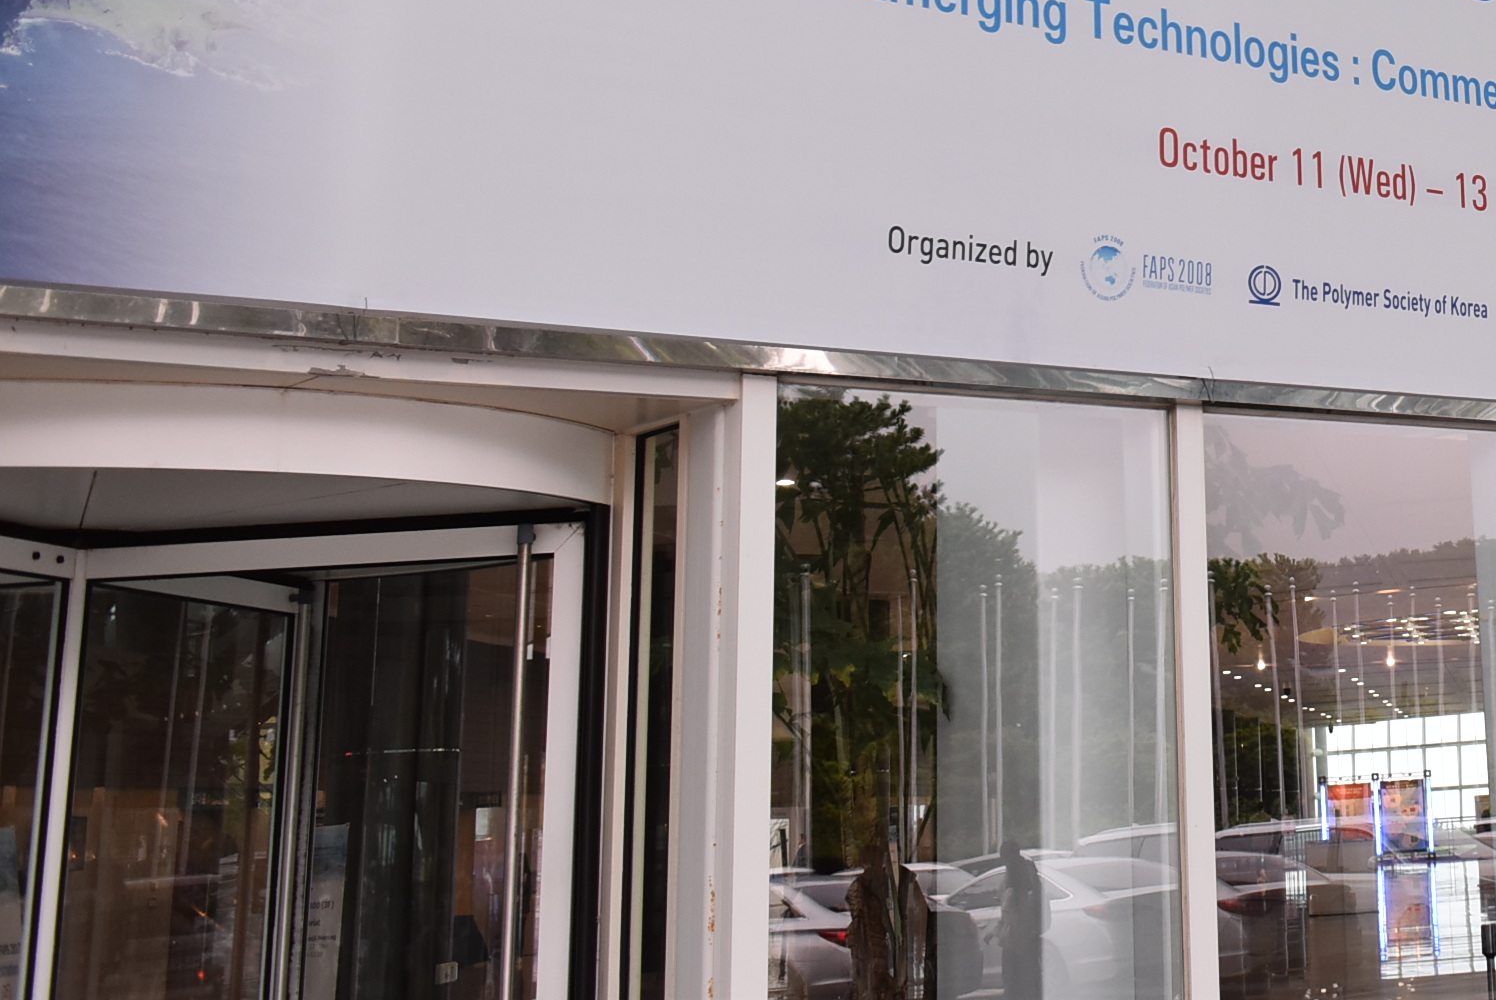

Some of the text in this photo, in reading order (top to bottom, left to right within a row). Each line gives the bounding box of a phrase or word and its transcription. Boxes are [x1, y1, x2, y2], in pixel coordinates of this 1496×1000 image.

[1160, 128, 1277, 181] October
[1293, 148, 1322, 188] 11
[1339, 155, 1415, 206] (Wed)
[1456, 173, 1487, 211] 13
[889, 226, 1053, 276] Organized by
[1093, 235, 1109, 244] FAPS
[1143, 255, 1212, 286] FAPS 2008
[1292, 279, 1487, 318] The Polymer Society of Korea
